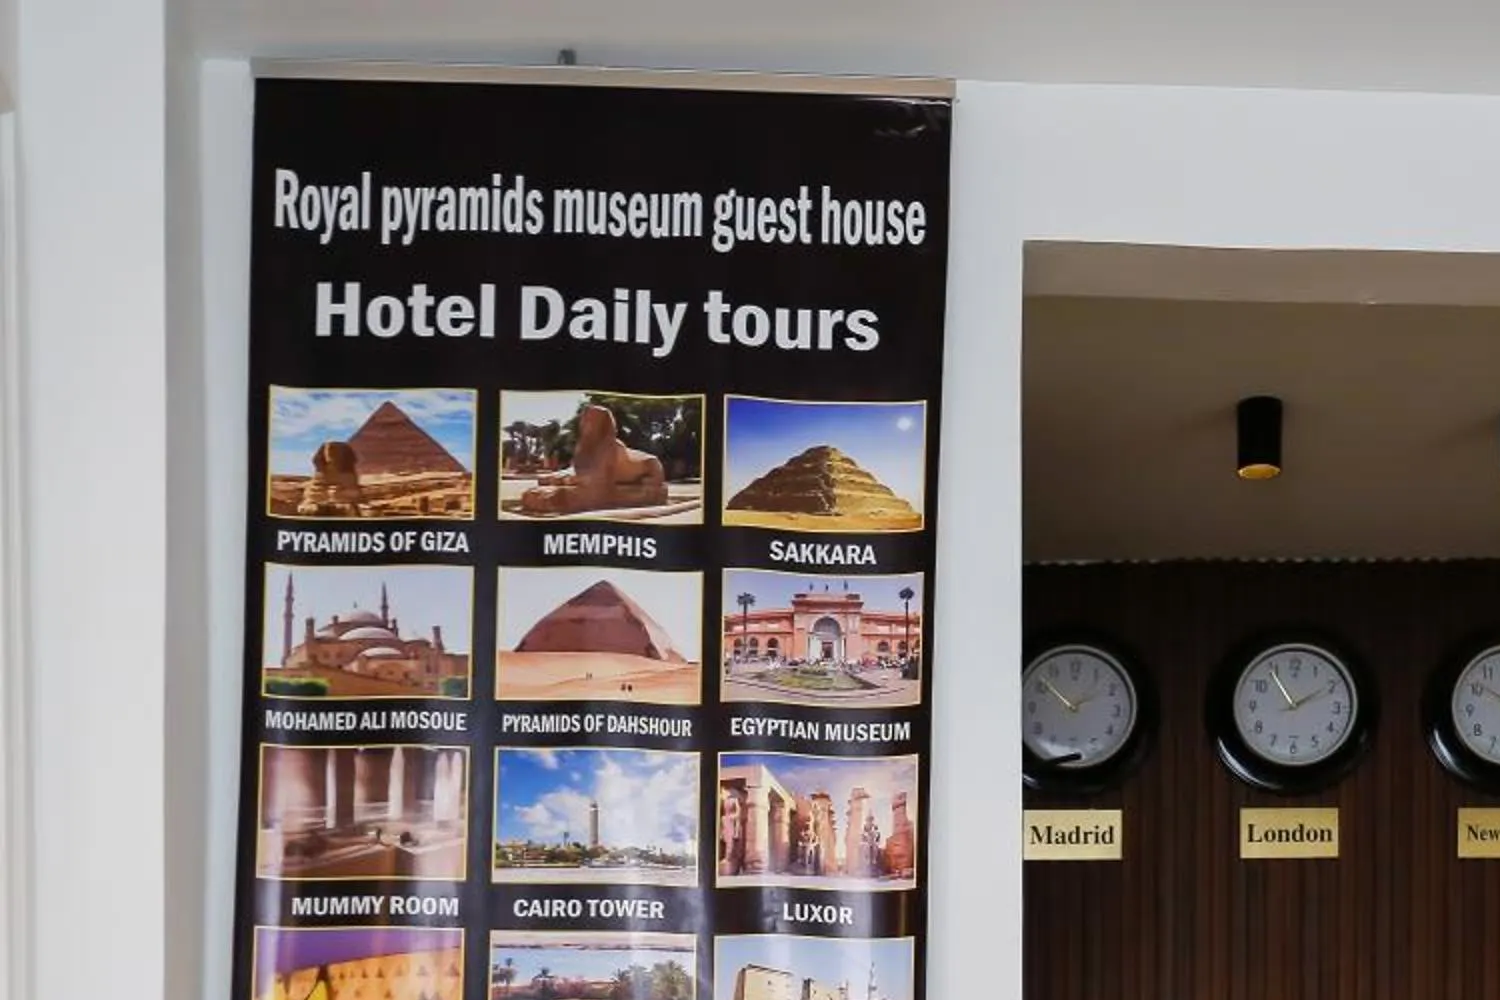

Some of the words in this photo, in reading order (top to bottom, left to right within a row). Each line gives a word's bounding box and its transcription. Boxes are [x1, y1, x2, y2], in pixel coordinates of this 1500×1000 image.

[274, 168, 371, 245] Royal
[381, 173, 544, 246] pyramids
[553, 189, 703, 239] museum
[711, 185, 813, 253] guest
[821, 185, 926, 246] house
[315, 282, 496, 338] Hotel
[520, 285, 688, 358] Daily
[703, 290, 880, 351] tours
[277, 530, 386, 553] PYRAMIDS
[389, 531, 417, 552] OF
[420, 531, 469, 553] GIZA
[544, 533, 657, 559] MEMPHIS
[769, 540, 877, 565] SAKKARA
[265, 709, 357, 731] MOHAMED
[359, 711, 387, 730] ALI
[502, 714, 581, 733] PYRAMIDS
[583, 714, 605, 733] OF
[607, 714, 692, 737] DAHSHOUR
[731, 717, 819, 741] EGYPTIAN
[825, 722, 910, 742] MUSEUM
[1030, 825, 1115, 845] Madrid
[1247, 823, 1333, 843] London
[1466, 824, 1500, 841] New
[291, 895, 385, 916] MUMMY
[390, 895, 459, 917] ROOM
[513, 899, 583, 918] CAIRO
[586, 899, 664, 919] TOWER
[782, 902, 853, 924] LUXOR
